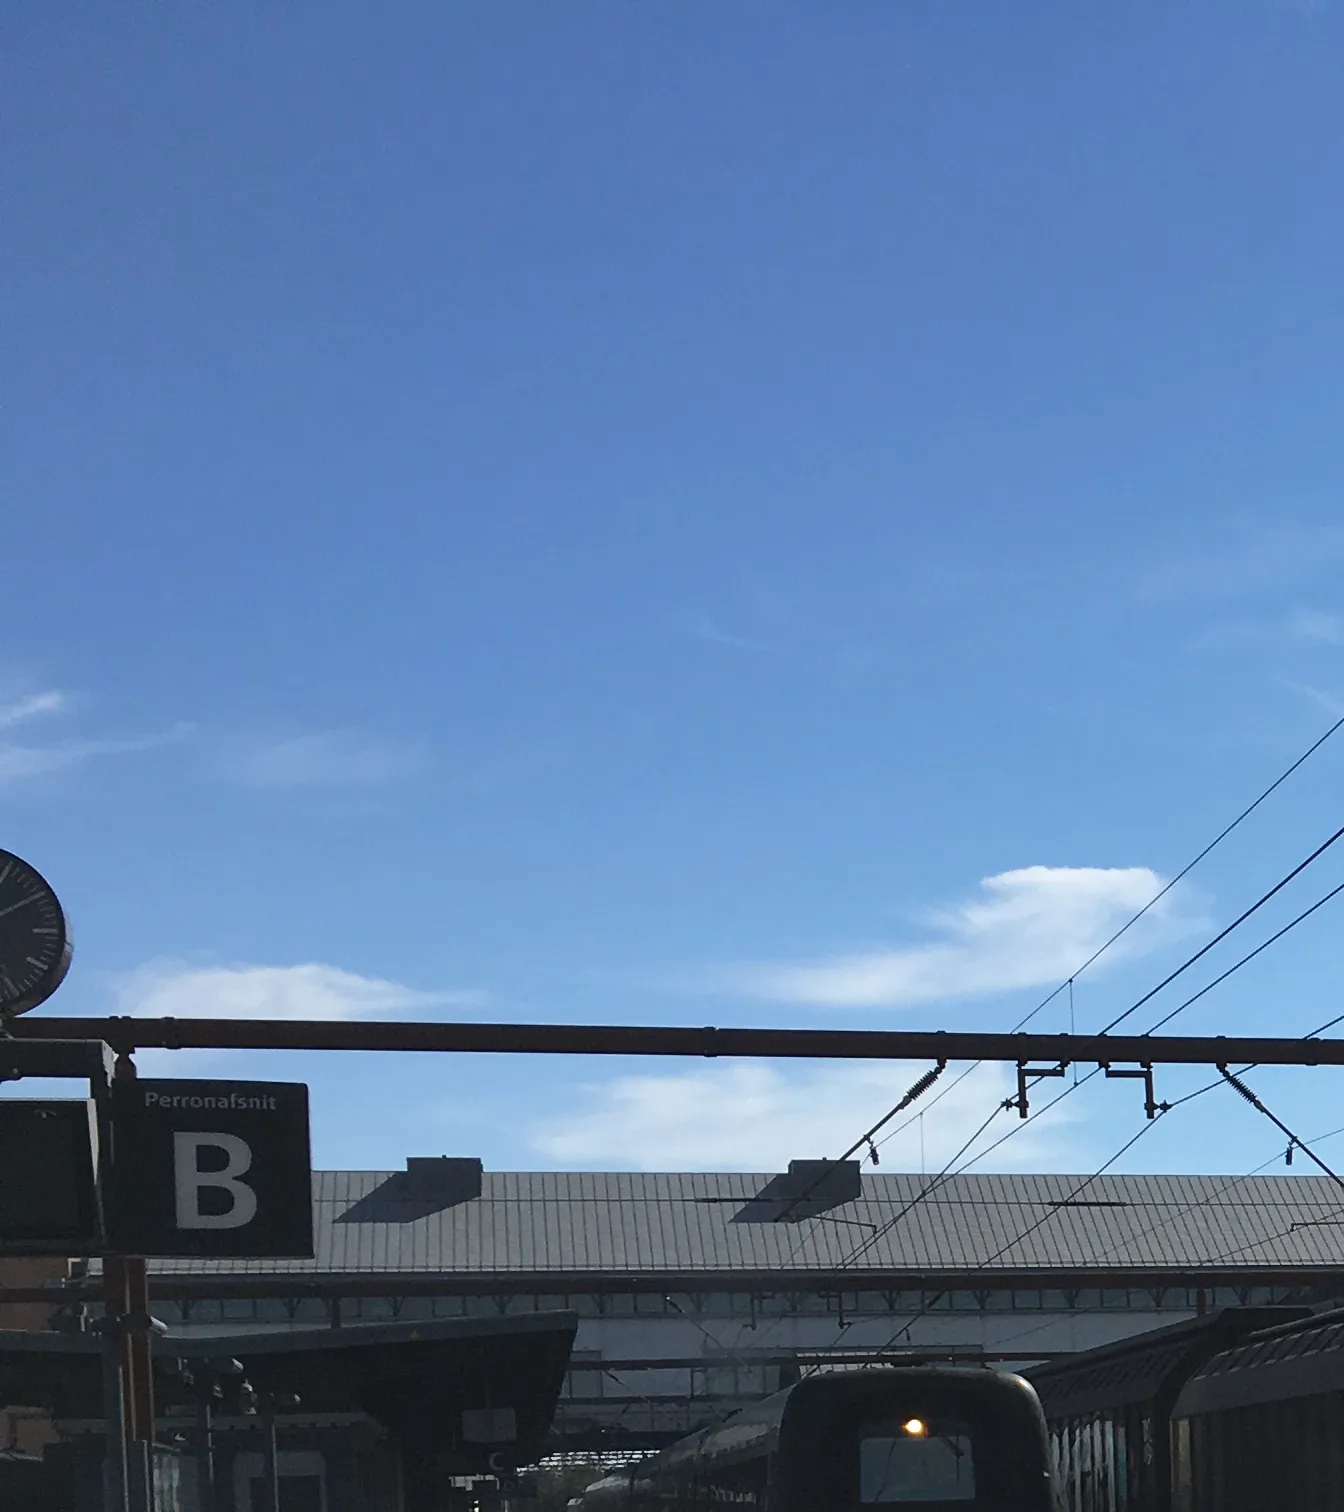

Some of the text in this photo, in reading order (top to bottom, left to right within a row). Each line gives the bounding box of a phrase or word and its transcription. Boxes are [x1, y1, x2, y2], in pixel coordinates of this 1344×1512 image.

[144, 1090, 278, 1111] Perronafsnit
[172, 1130, 259, 1231] B
[488, 1451, 505, 1472] C
